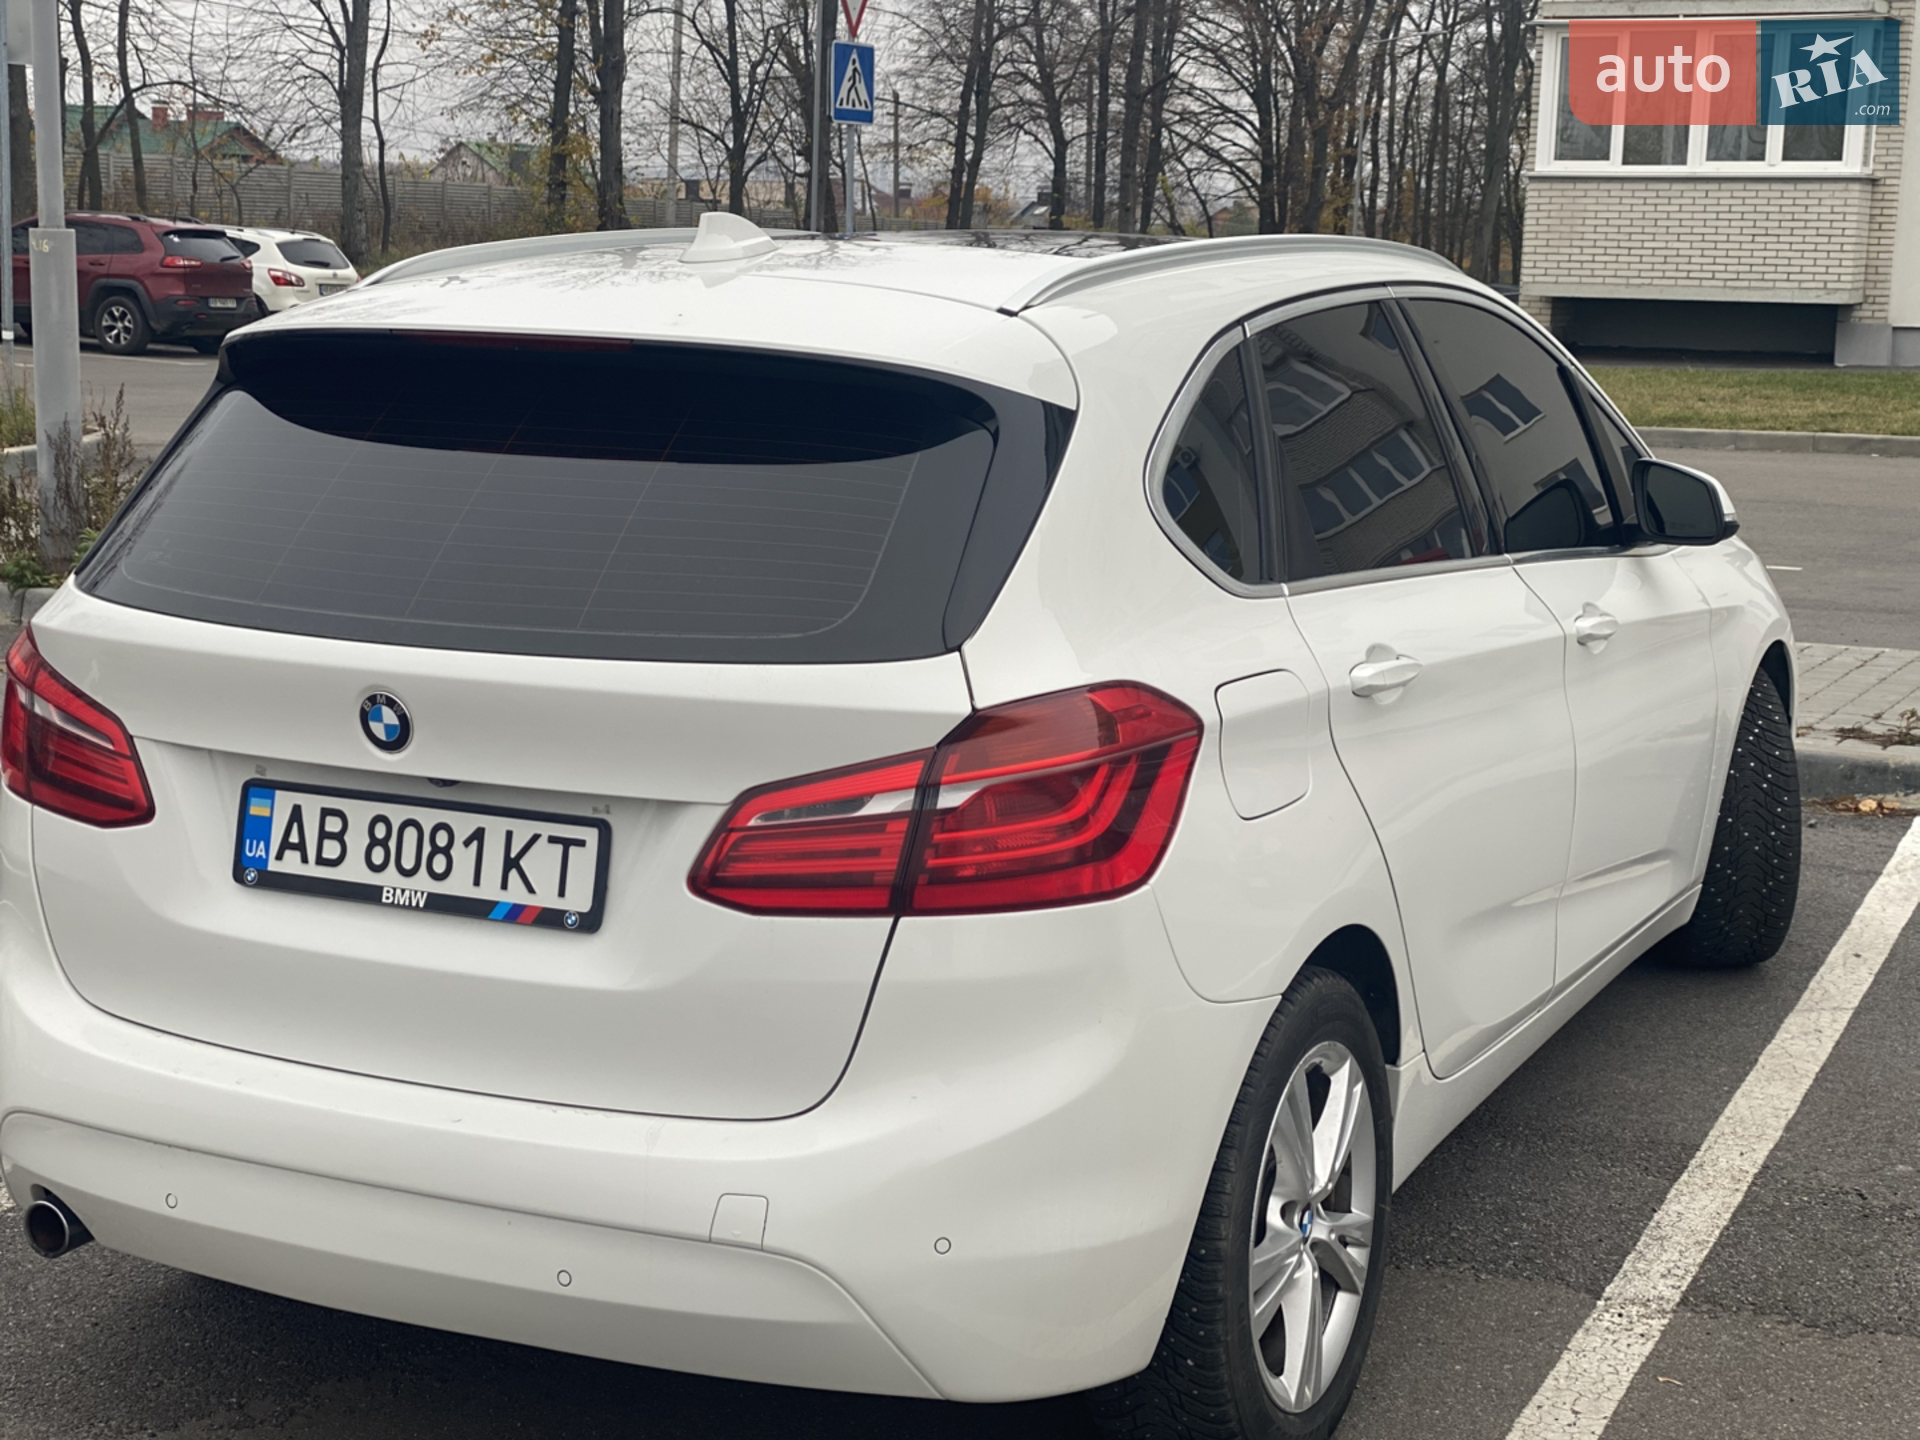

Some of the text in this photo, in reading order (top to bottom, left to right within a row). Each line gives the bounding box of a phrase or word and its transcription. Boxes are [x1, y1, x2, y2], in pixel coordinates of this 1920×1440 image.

[244, 838, 267, 859] UA
[274, 803, 587, 899] AB 8081 KT
[380, 886, 428, 908] BMW
